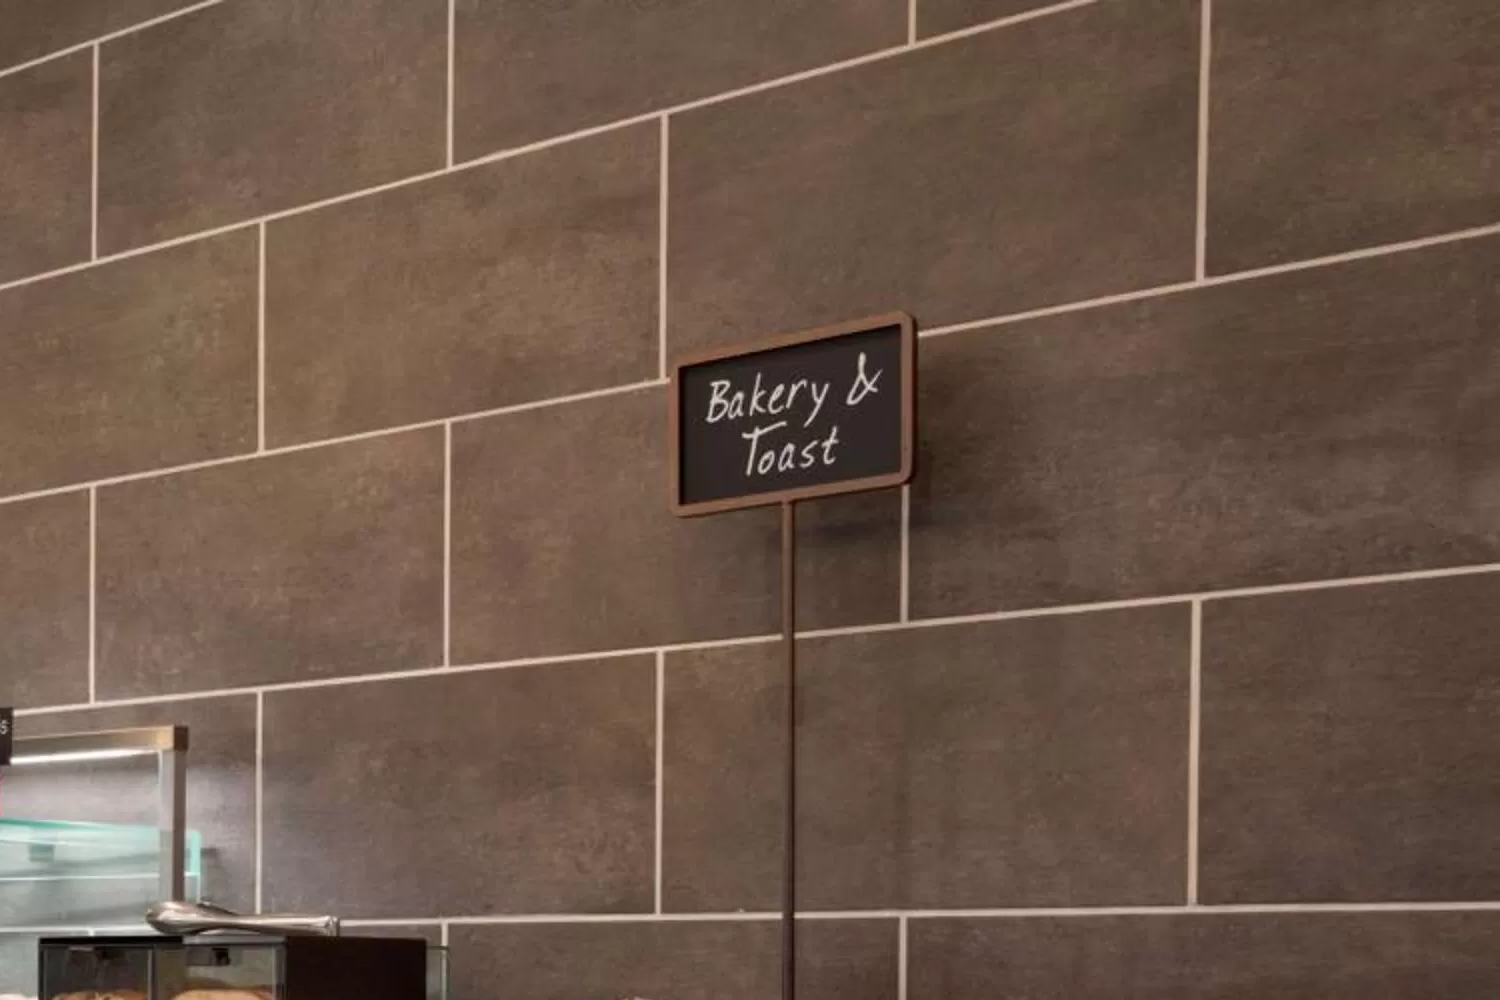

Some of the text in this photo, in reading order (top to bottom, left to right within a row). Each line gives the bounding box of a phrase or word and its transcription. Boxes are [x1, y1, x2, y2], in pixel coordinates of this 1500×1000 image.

[704, 351, 884, 428] Bakery &
[741, 419, 840, 477] Toast
